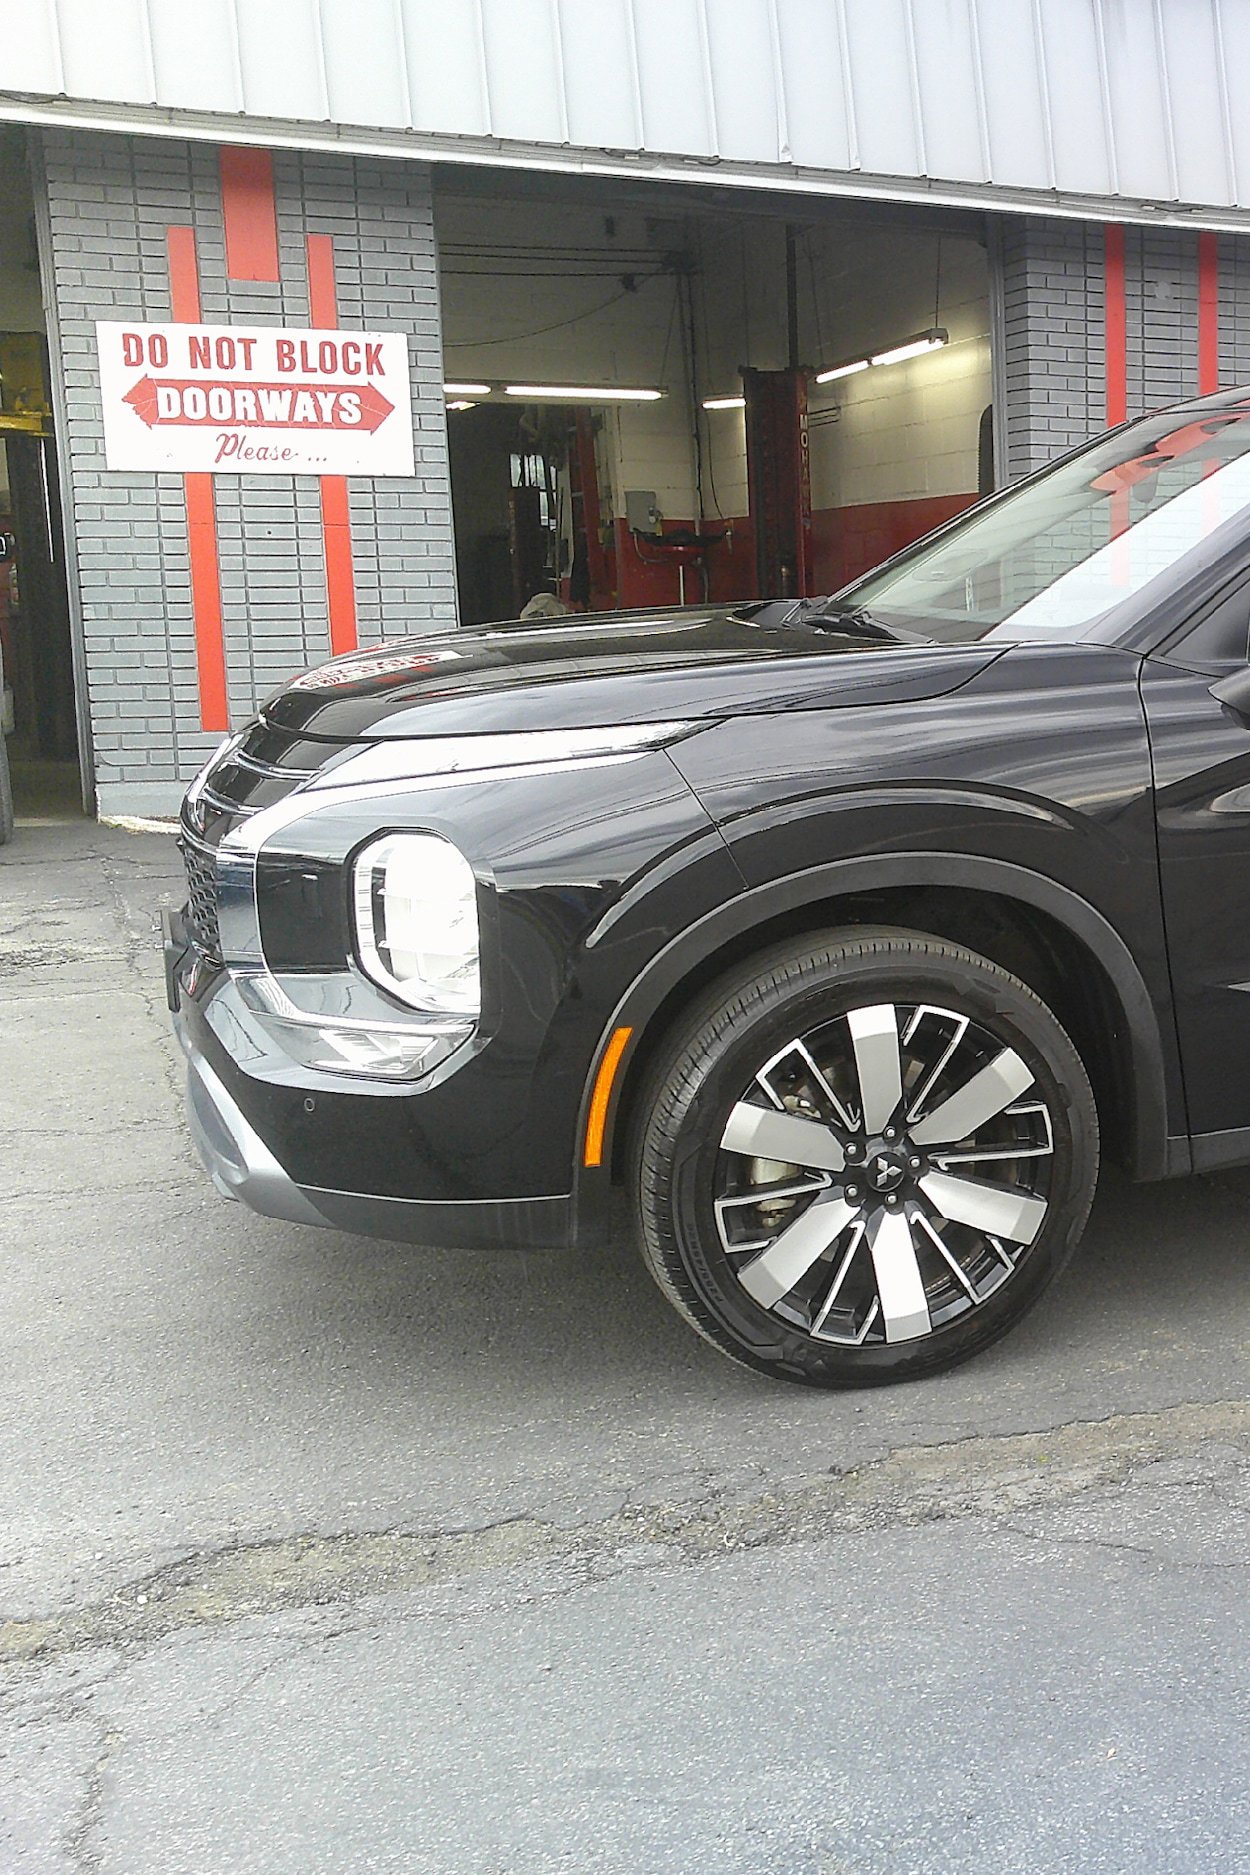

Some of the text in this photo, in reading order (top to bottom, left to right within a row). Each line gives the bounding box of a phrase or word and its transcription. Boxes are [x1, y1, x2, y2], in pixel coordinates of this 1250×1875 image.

[122, 332, 386, 376] DO NOT BLOCK
[155, 385, 364, 425] DOORWAYS
